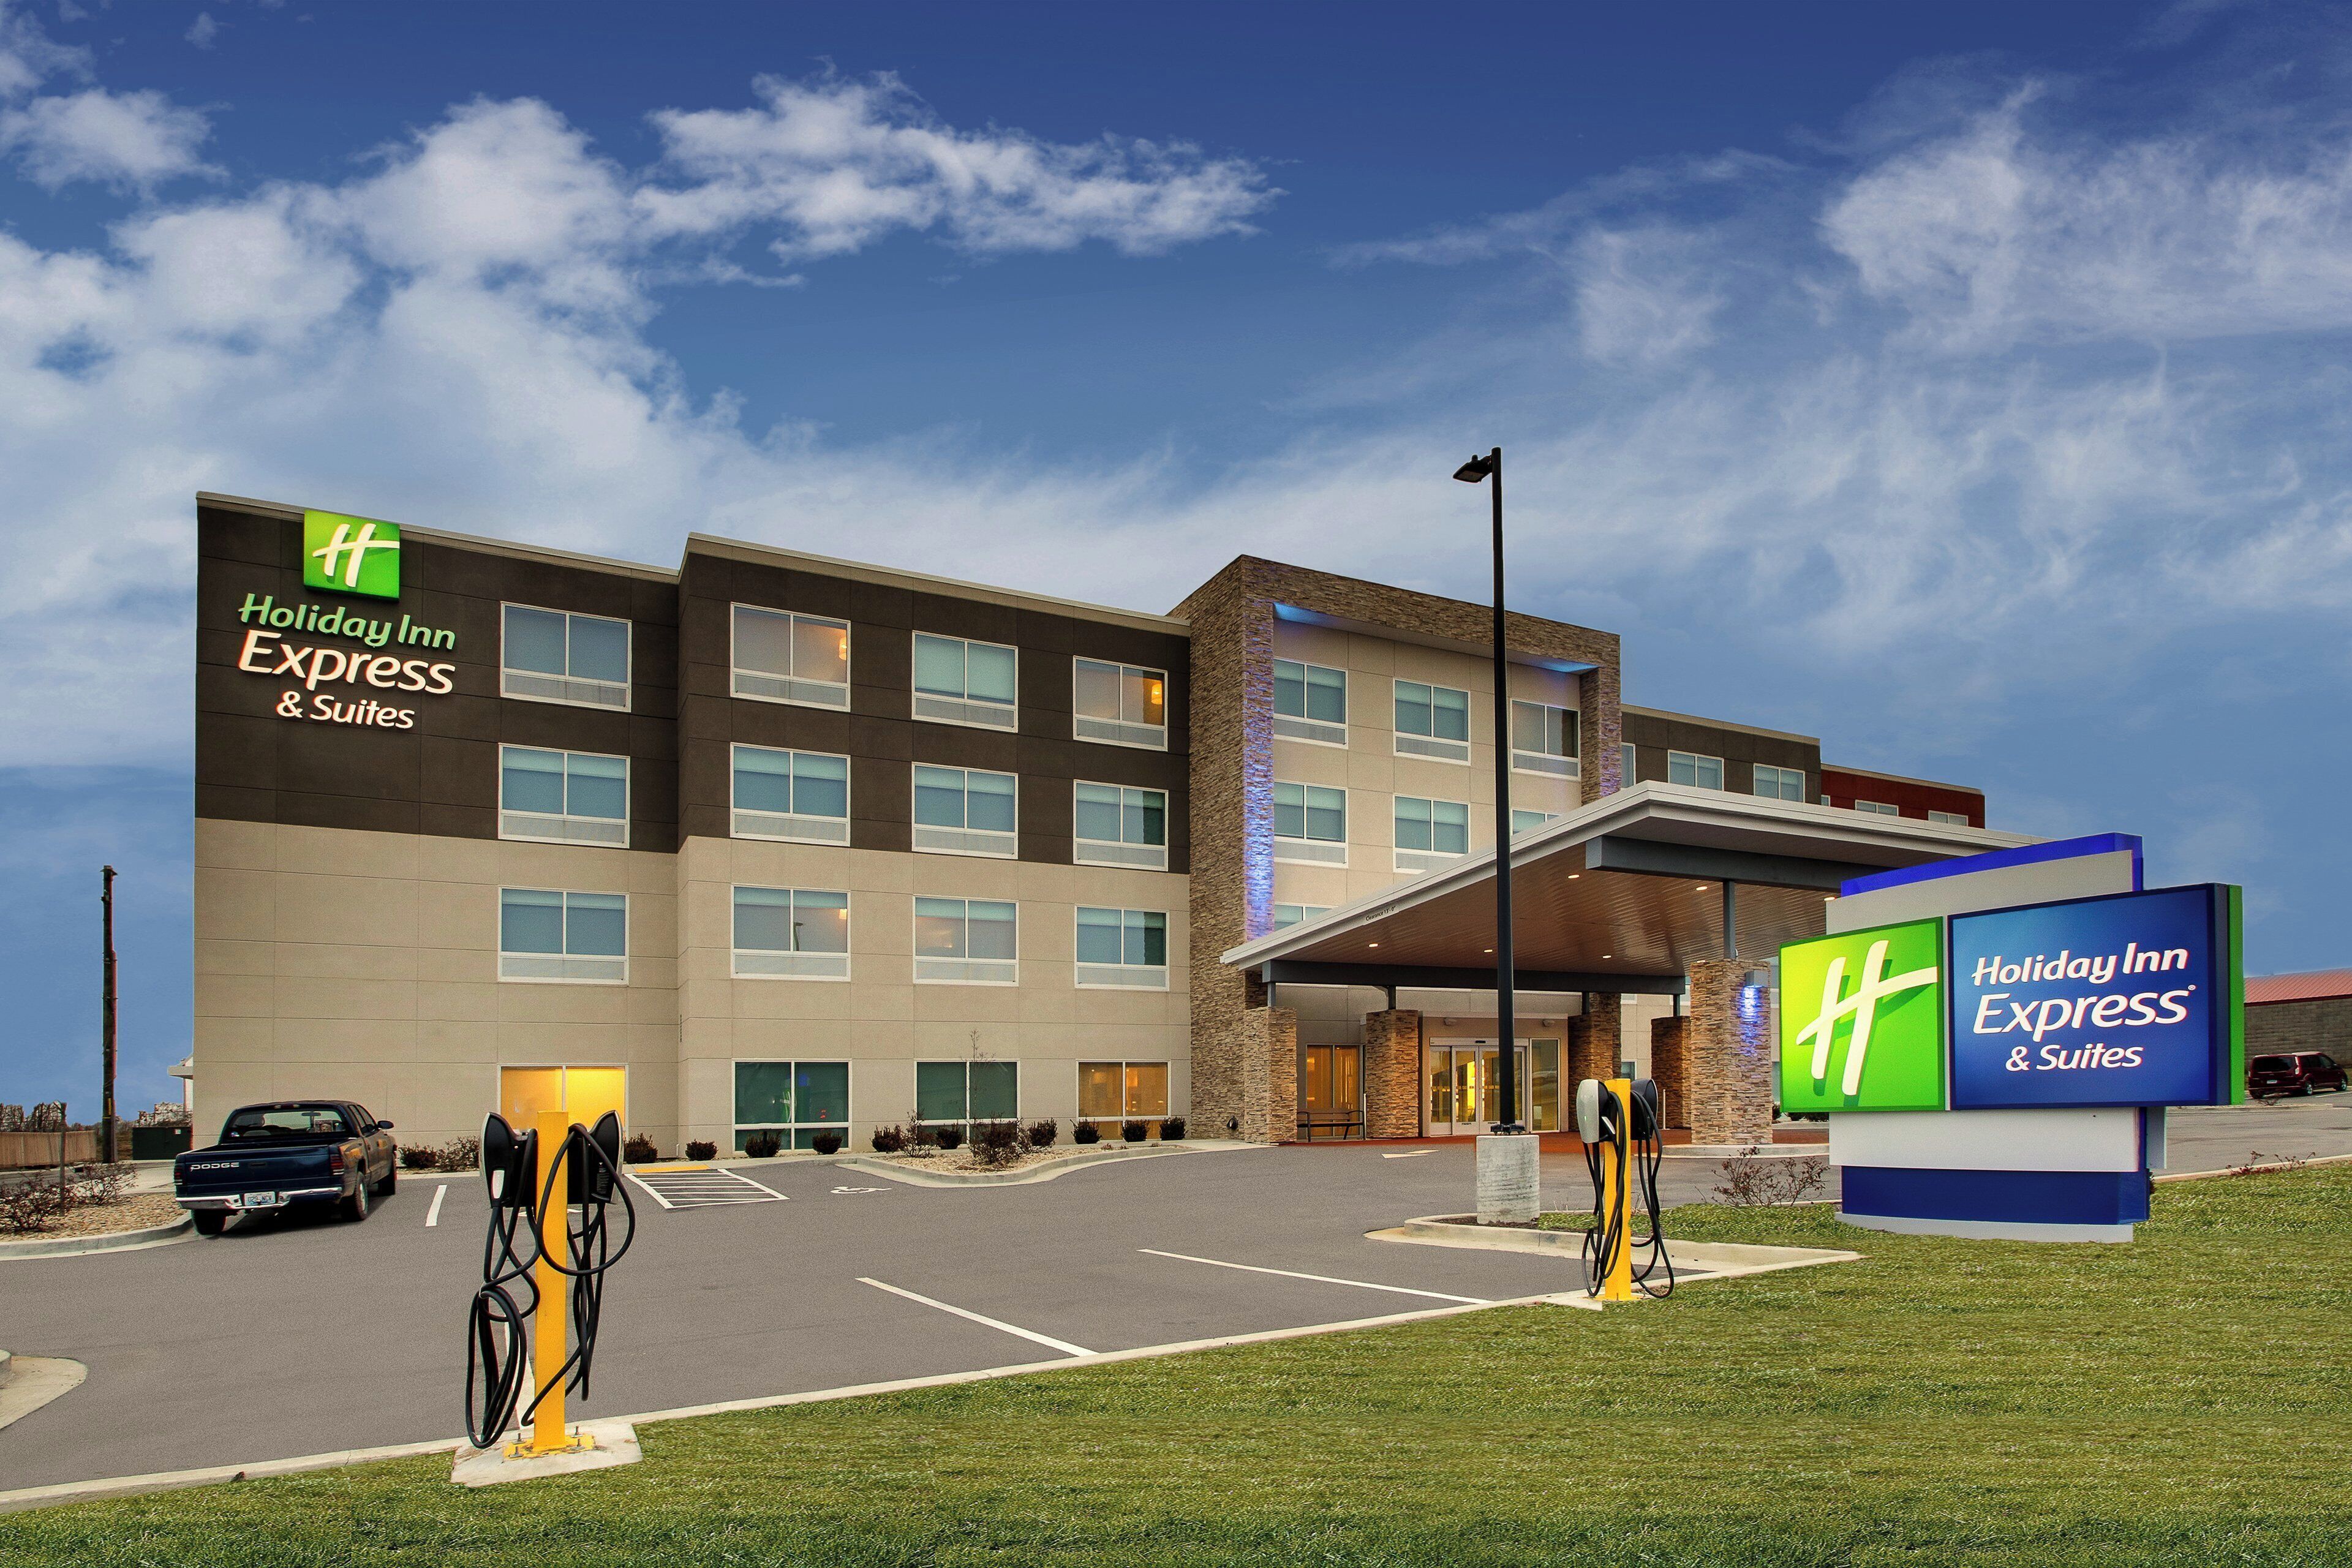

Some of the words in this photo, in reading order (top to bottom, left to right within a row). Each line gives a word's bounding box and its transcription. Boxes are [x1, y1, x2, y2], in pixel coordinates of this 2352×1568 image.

[238, 593, 392, 647] Holiday
[398, 614, 456, 650] Inn
[238, 629, 456, 694] Express
[276, 691, 303, 718] &
[309, 694, 415, 729] Suites
[1971, 950, 2117, 986] Holiday
[2122, 943, 2189, 974] Inn
[2005, 1046, 2030, 1071] &
[2036, 1043, 2144, 1071] Suites
